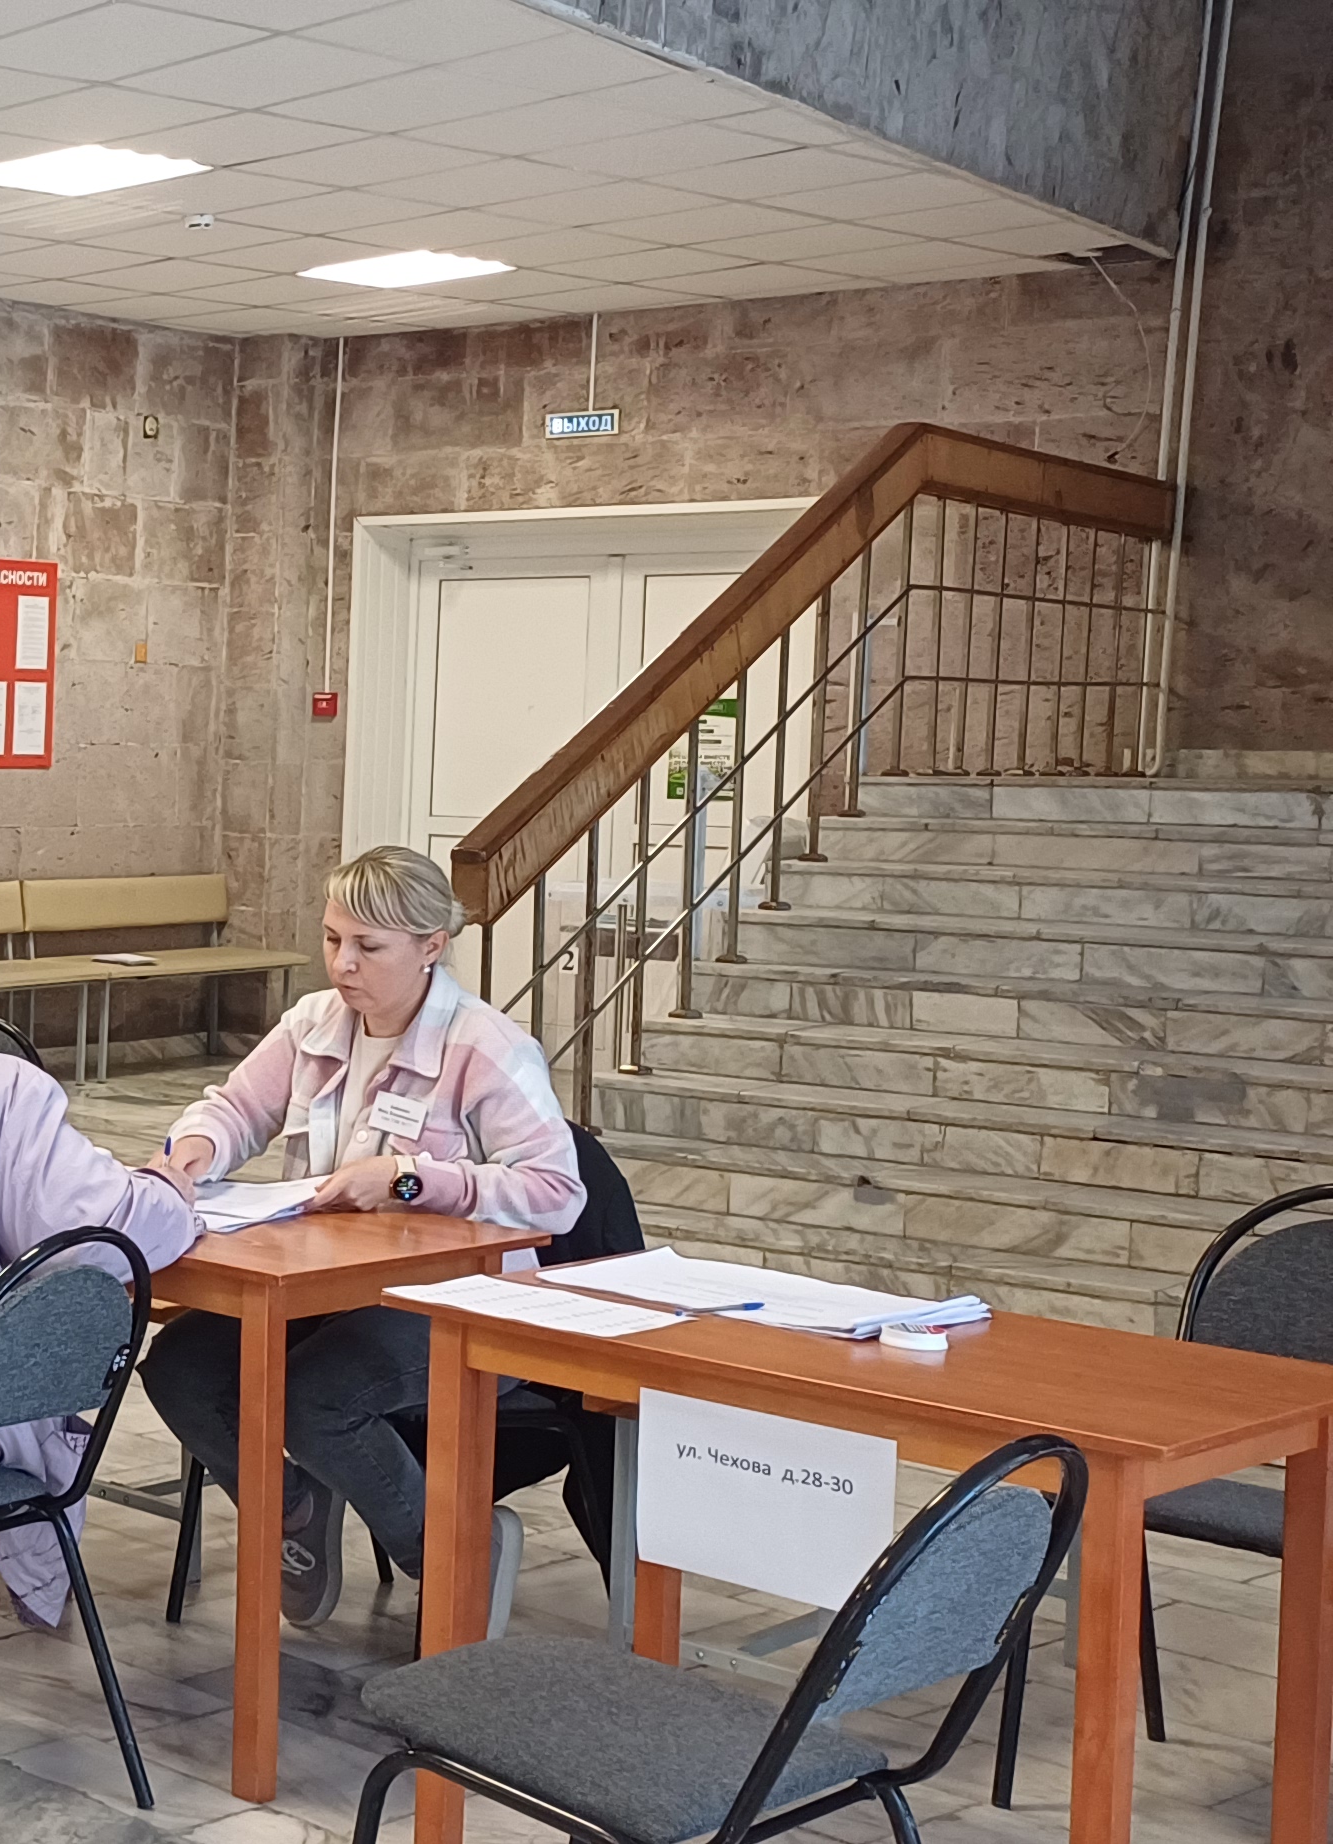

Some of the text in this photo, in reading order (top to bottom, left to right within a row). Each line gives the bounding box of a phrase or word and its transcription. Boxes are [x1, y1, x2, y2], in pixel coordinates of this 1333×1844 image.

[551, 415, 612, 434] ВЫХОД
[562, 950, 575, 971] 2
[676, 1443, 854, 1496] ул. Чехова д.28-30
